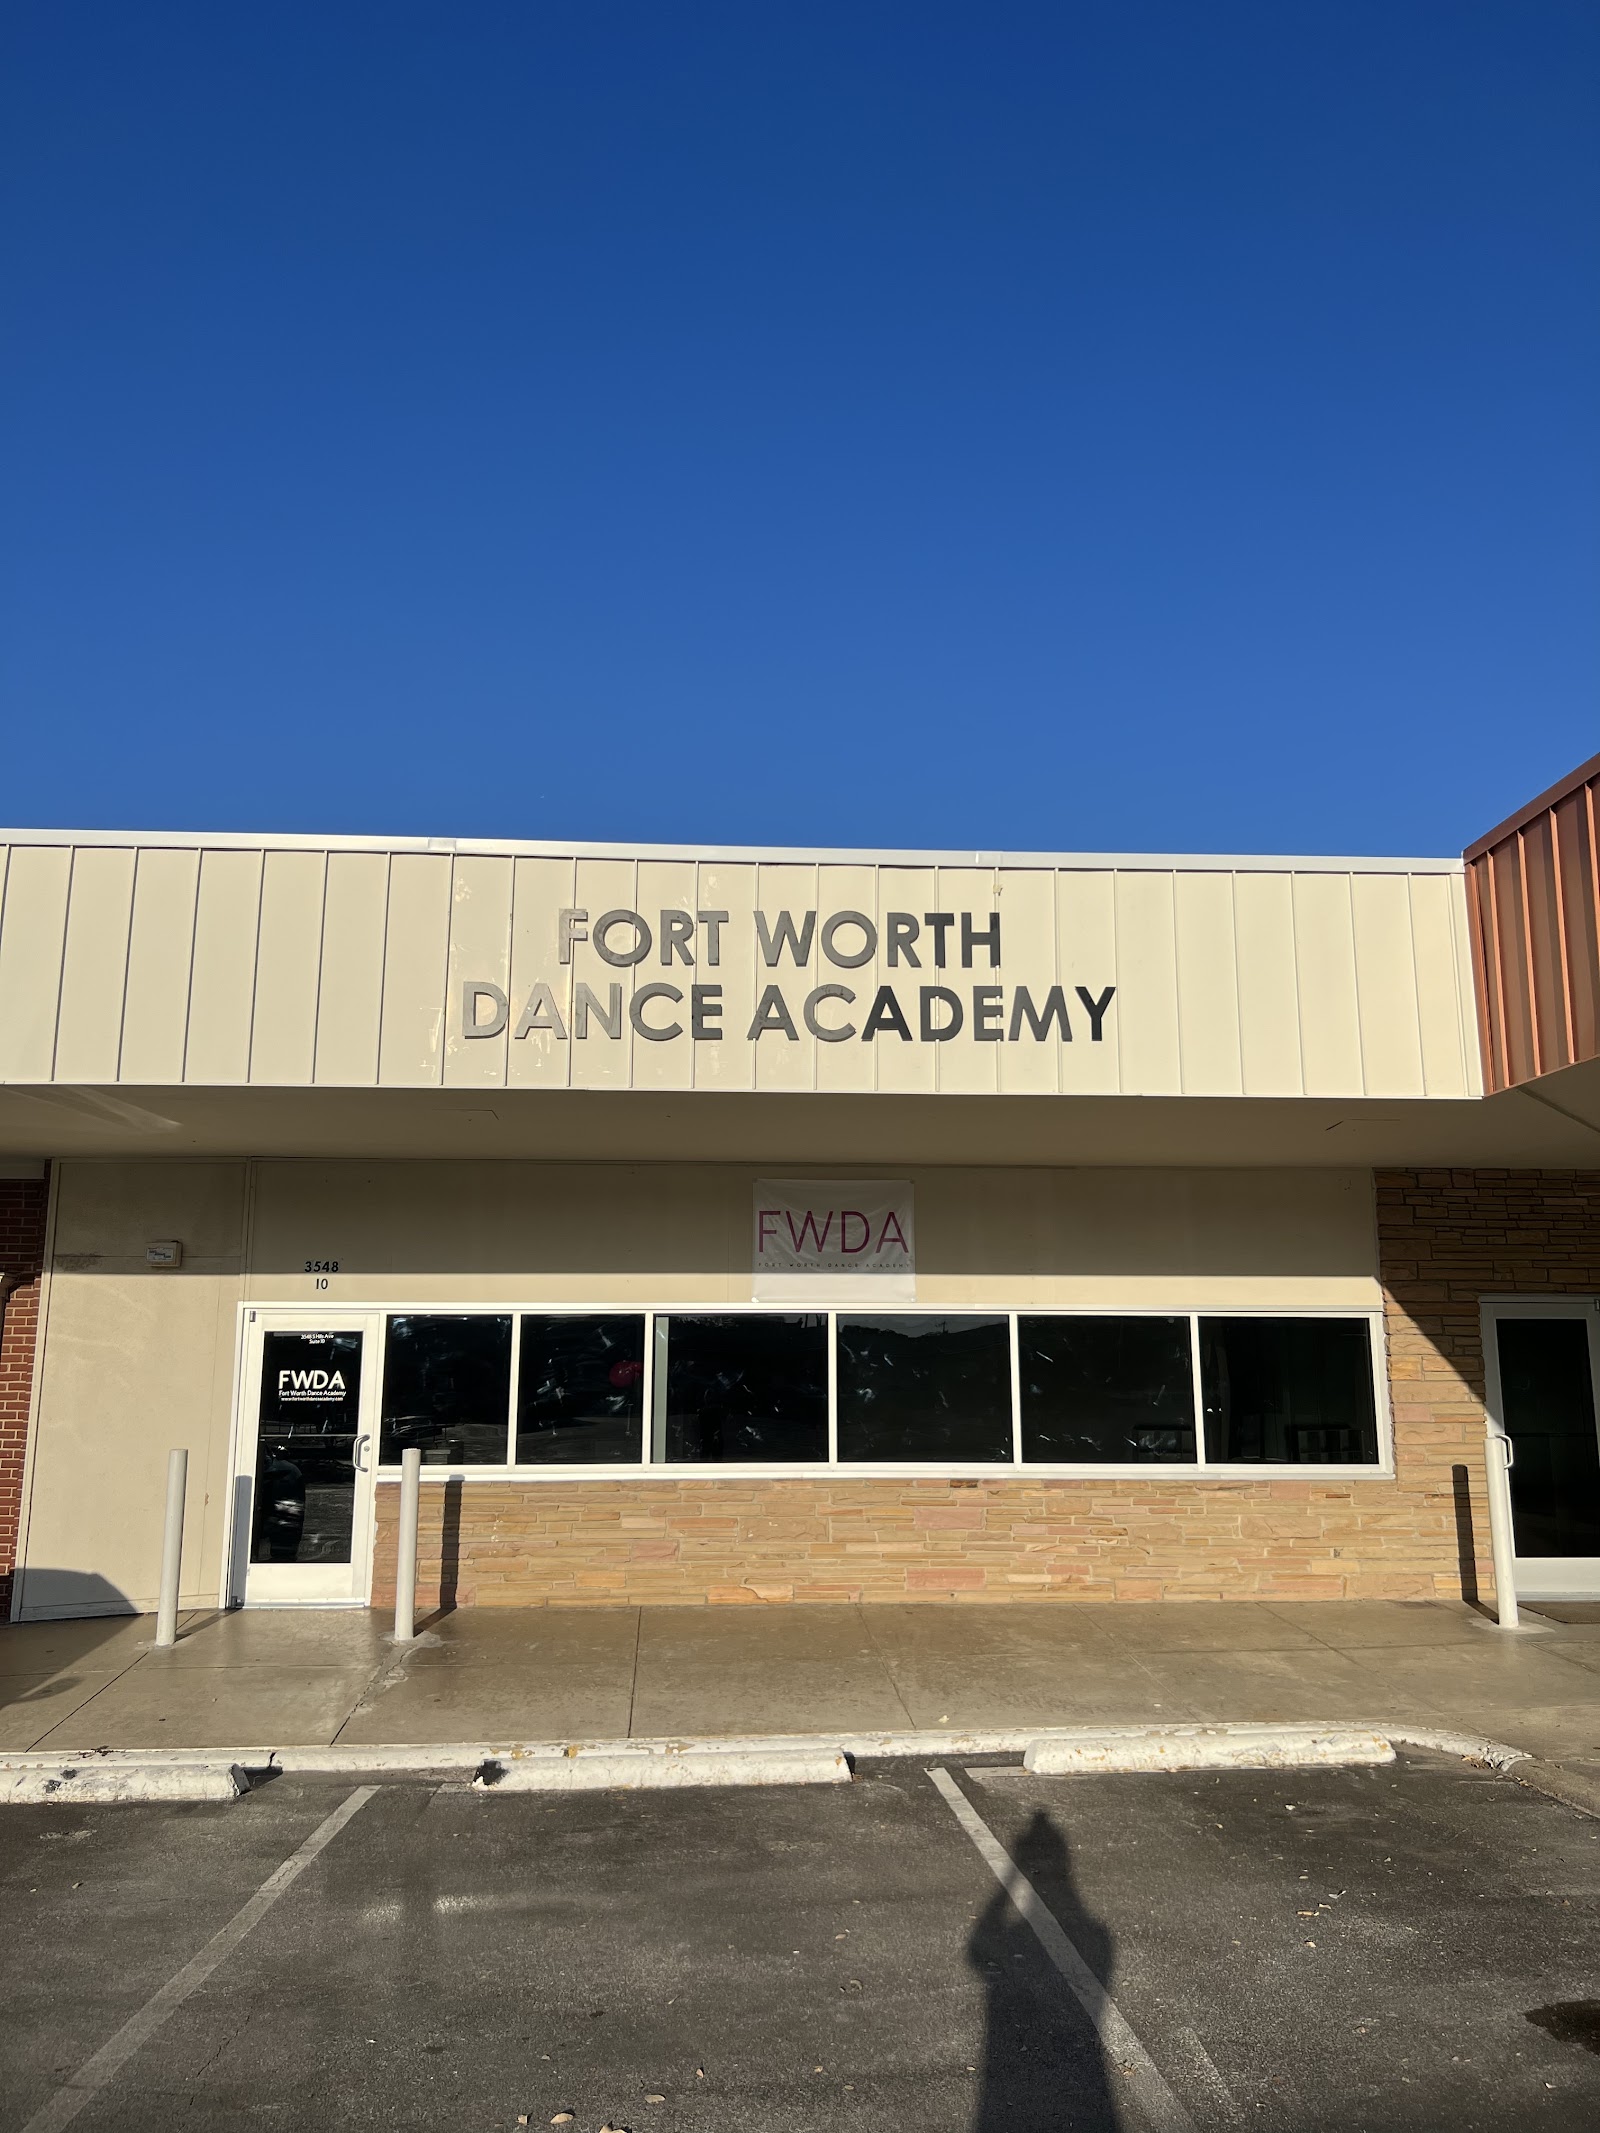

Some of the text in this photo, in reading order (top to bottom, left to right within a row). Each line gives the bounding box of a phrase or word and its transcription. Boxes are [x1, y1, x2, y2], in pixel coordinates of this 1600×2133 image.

[559, 908, 1001, 969] FORT WORTH
[462, 981, 1116, 1042] DANCE ACADEMY
[758, 1211, 909, 1253] FWDA
[304, 1261, 339, 1272] 3548
[316, 1278, 329, 1290] 10
[278, 1370, 346, 1389] FWDA
